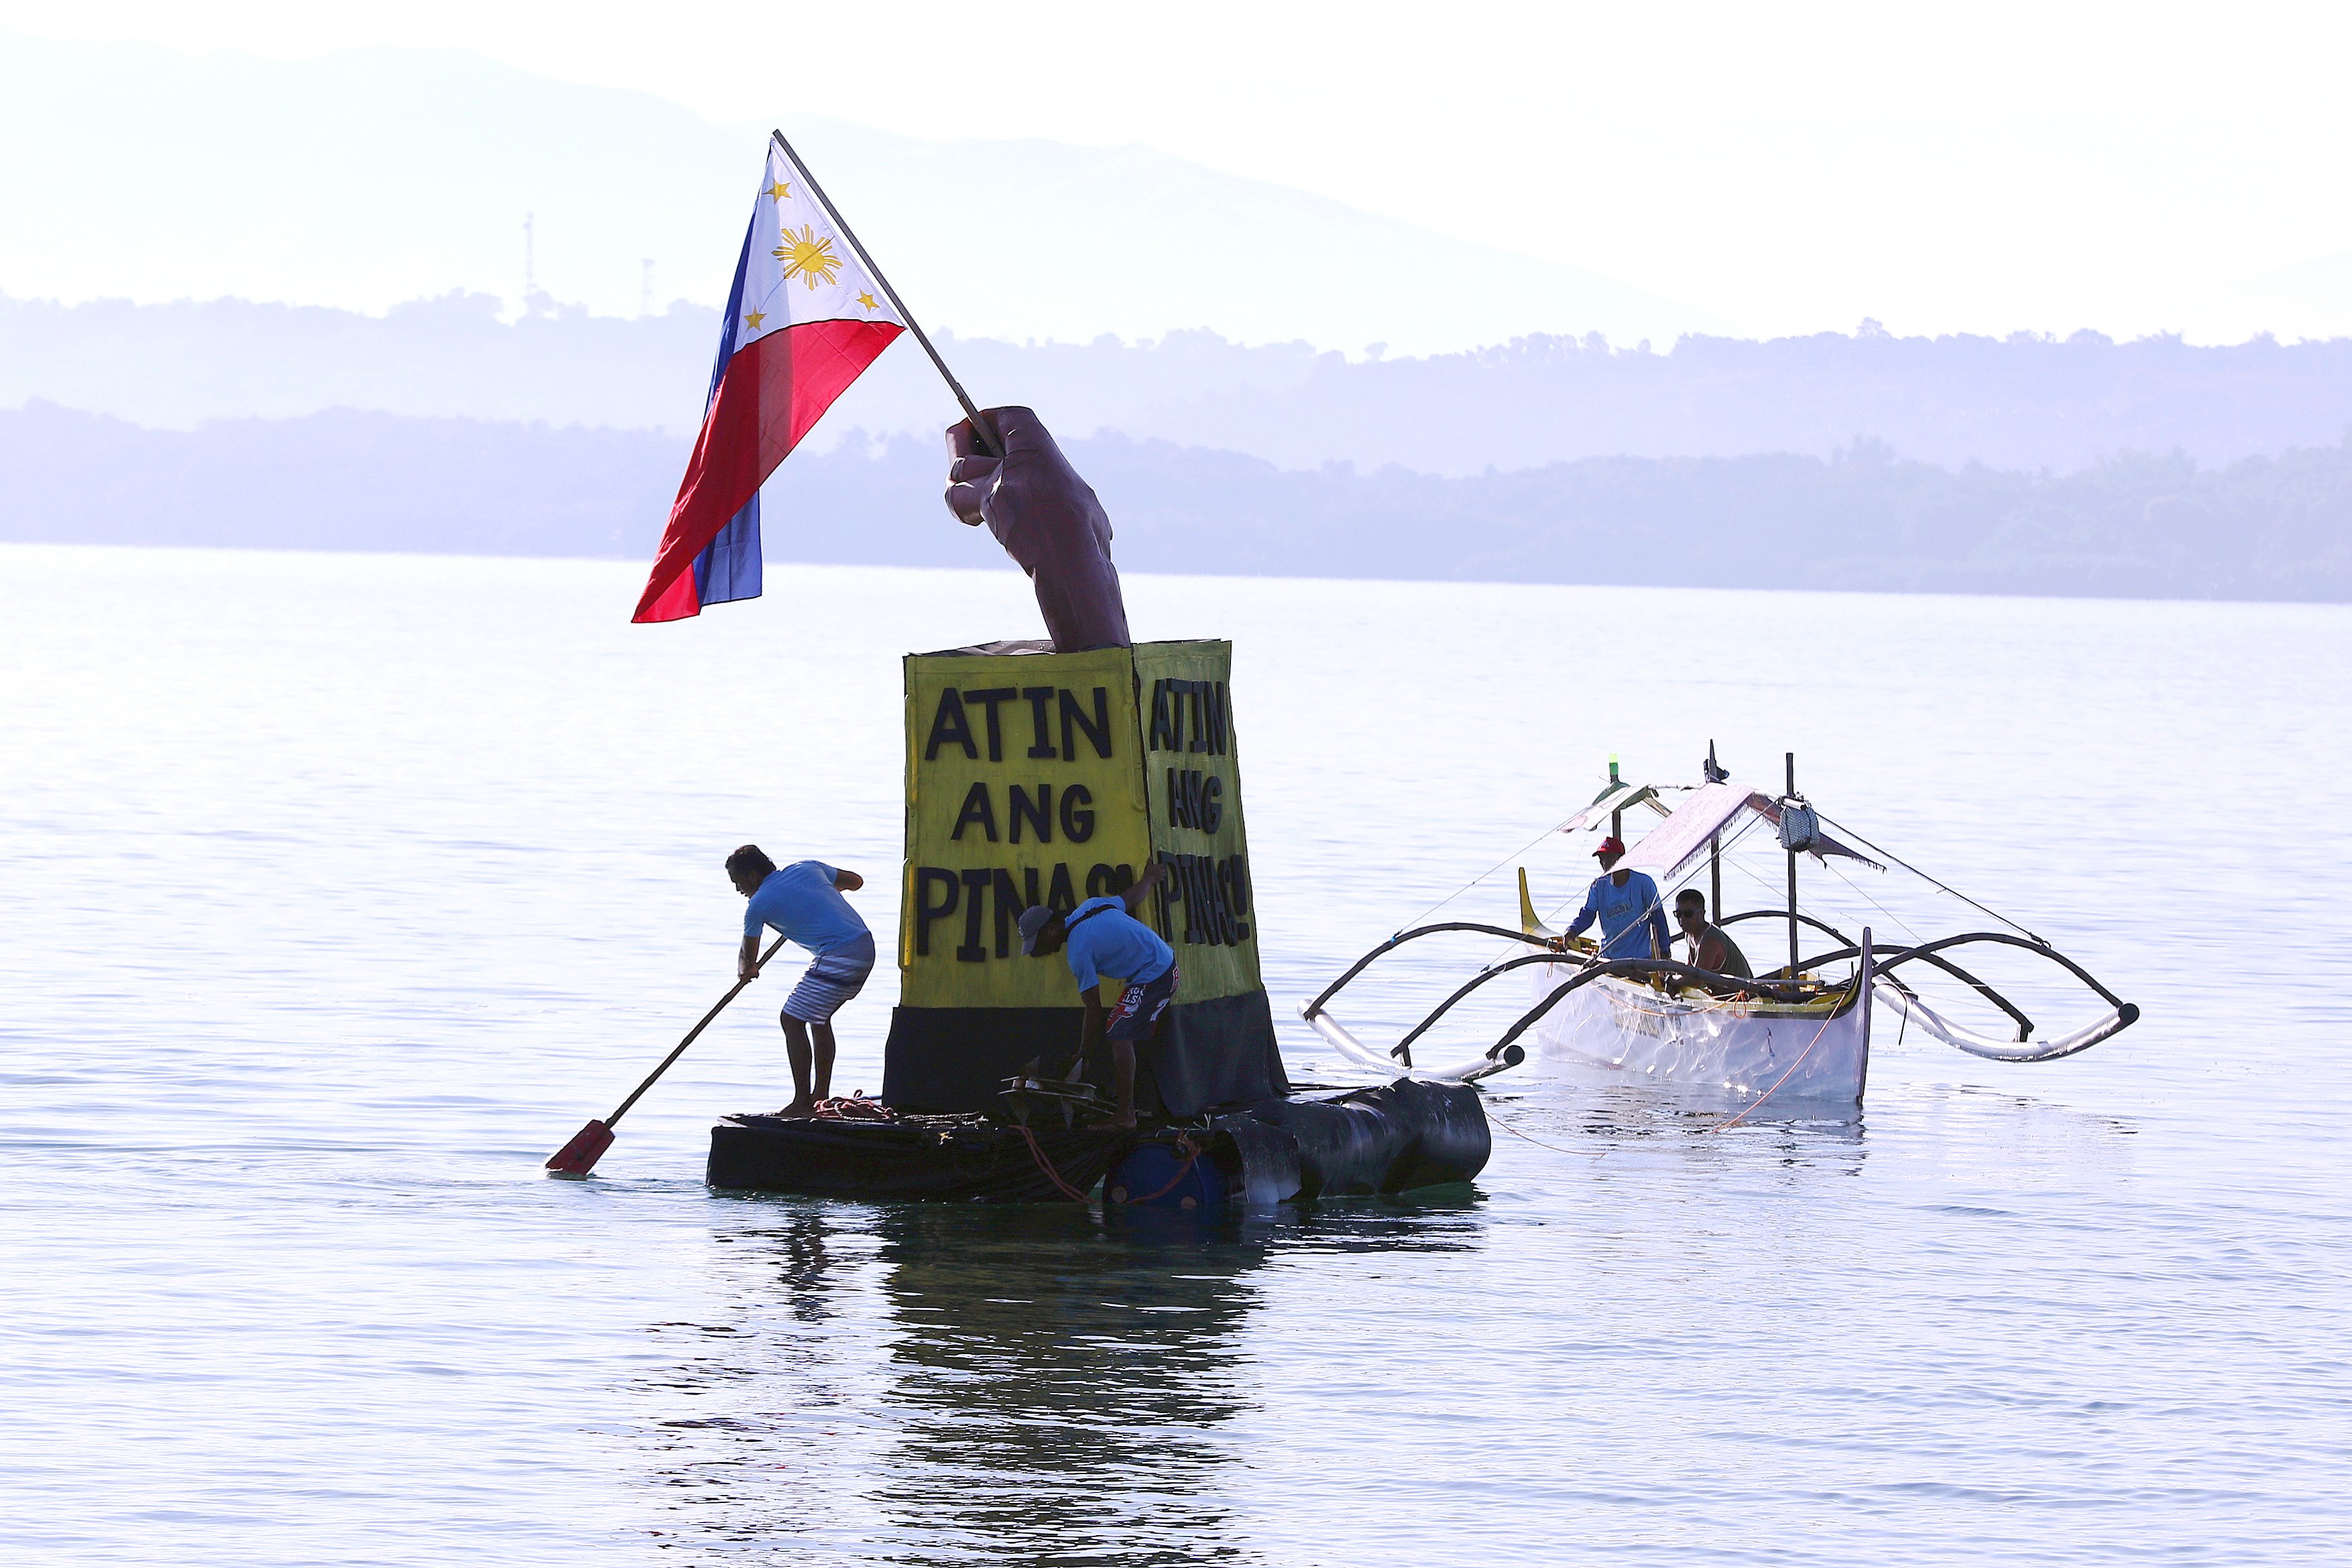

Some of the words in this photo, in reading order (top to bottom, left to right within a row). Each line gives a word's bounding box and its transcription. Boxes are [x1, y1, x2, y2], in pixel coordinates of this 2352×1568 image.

[925, 686, 1112, 762] ATIN
[1150, 678, 1226, 756] ATIN
[951, 782, 1094, 843] ANG
[1168, 768, 1222, 834] ANG
